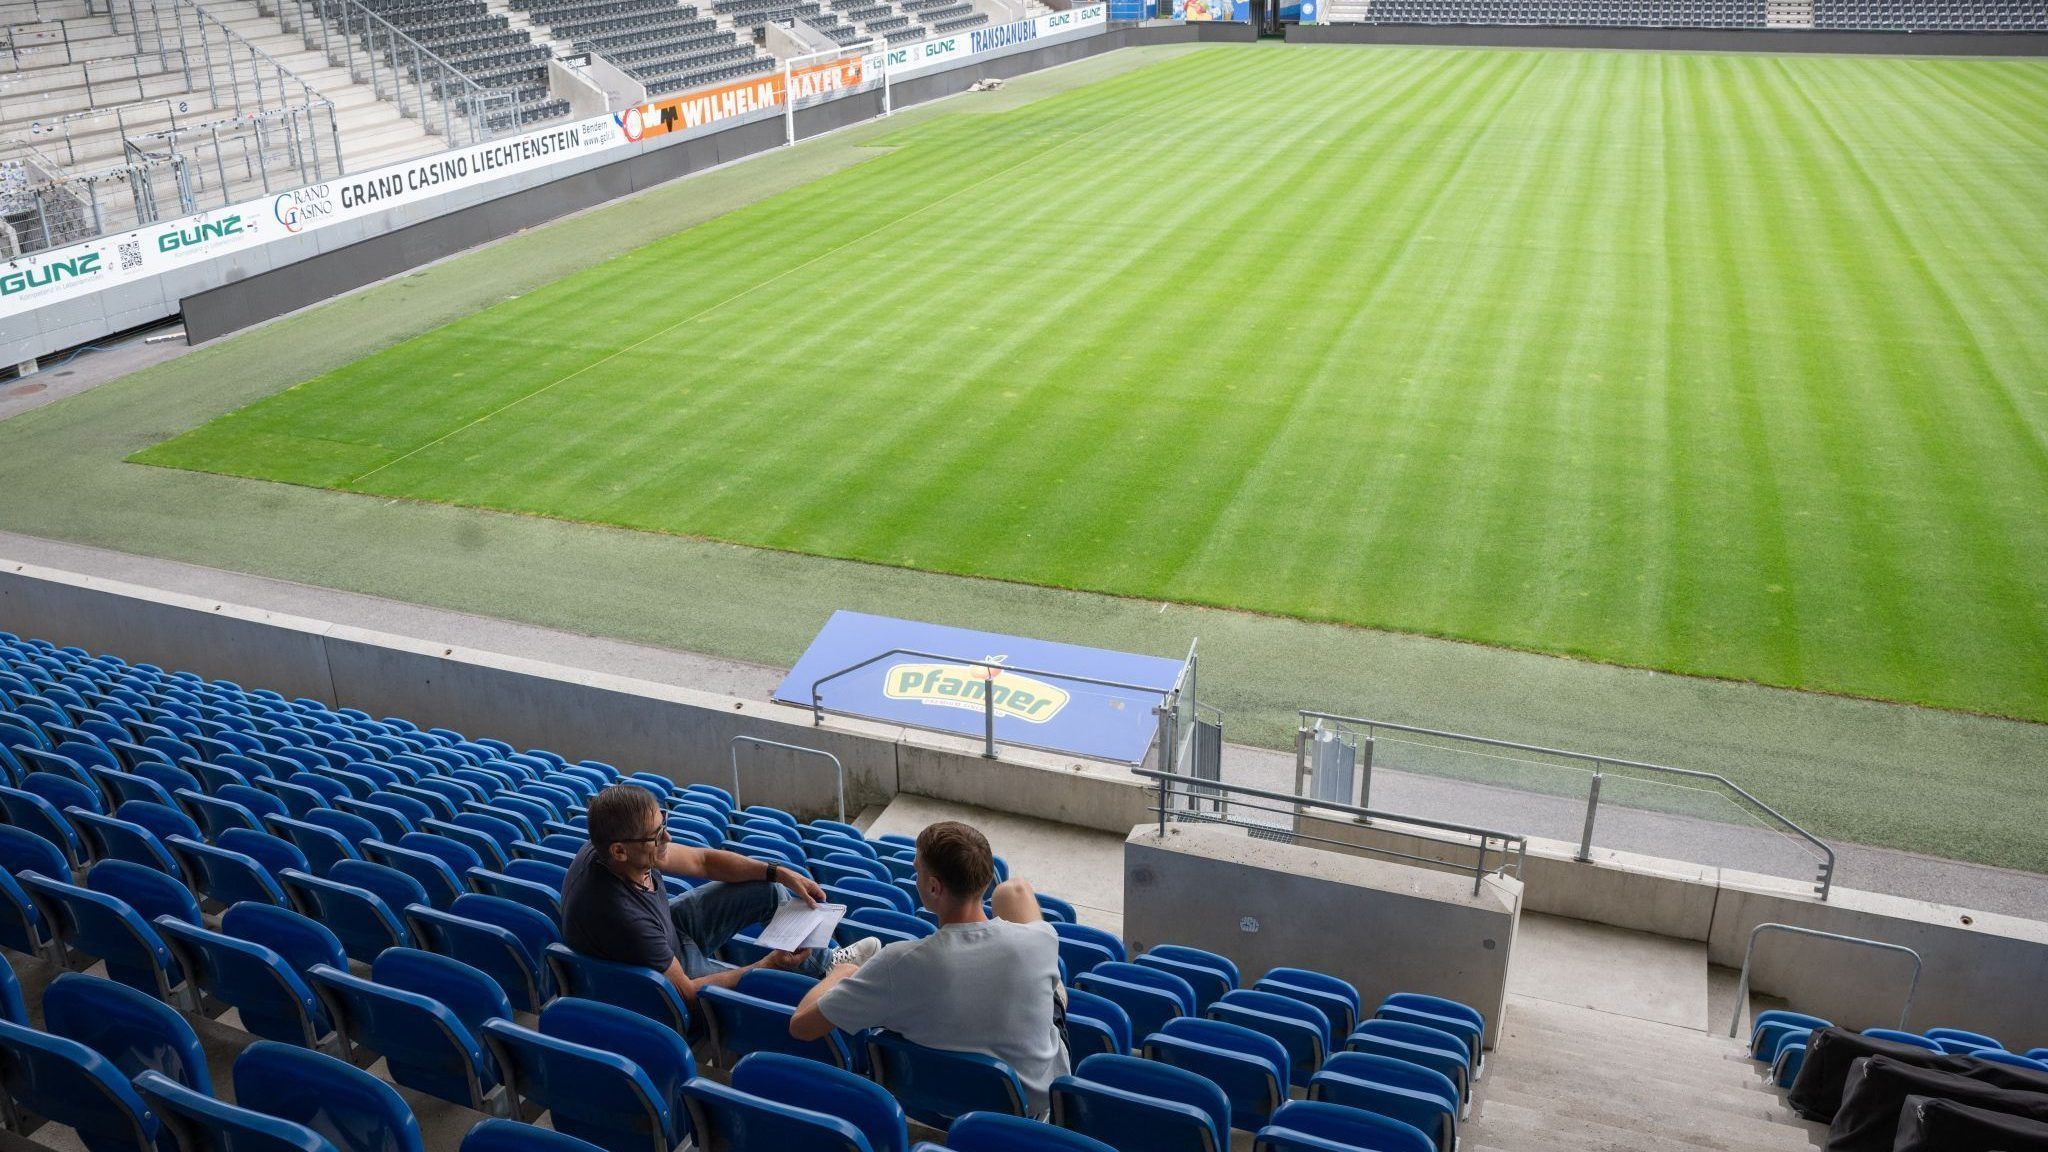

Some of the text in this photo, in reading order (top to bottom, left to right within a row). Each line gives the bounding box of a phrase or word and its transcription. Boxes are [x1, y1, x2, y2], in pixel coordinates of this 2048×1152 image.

[1050, 14, 1070, 27] GUNZ
[1081, 7, 1101, 19] GUNZ
[926, 39, 956, 57] GUNZ
[970, 19, 1037, 53] TRANSDANUBIA
[680, 67, 843, 128] WILHELM MAYER
[582, 121, 608, 134] Bendern
[341, 128, 580, 209] GRAND CASINO LIECHTENSTEIN
[158, 215, 243, 253] GUNZ
[0, 252, 102, 295] GUNZ
